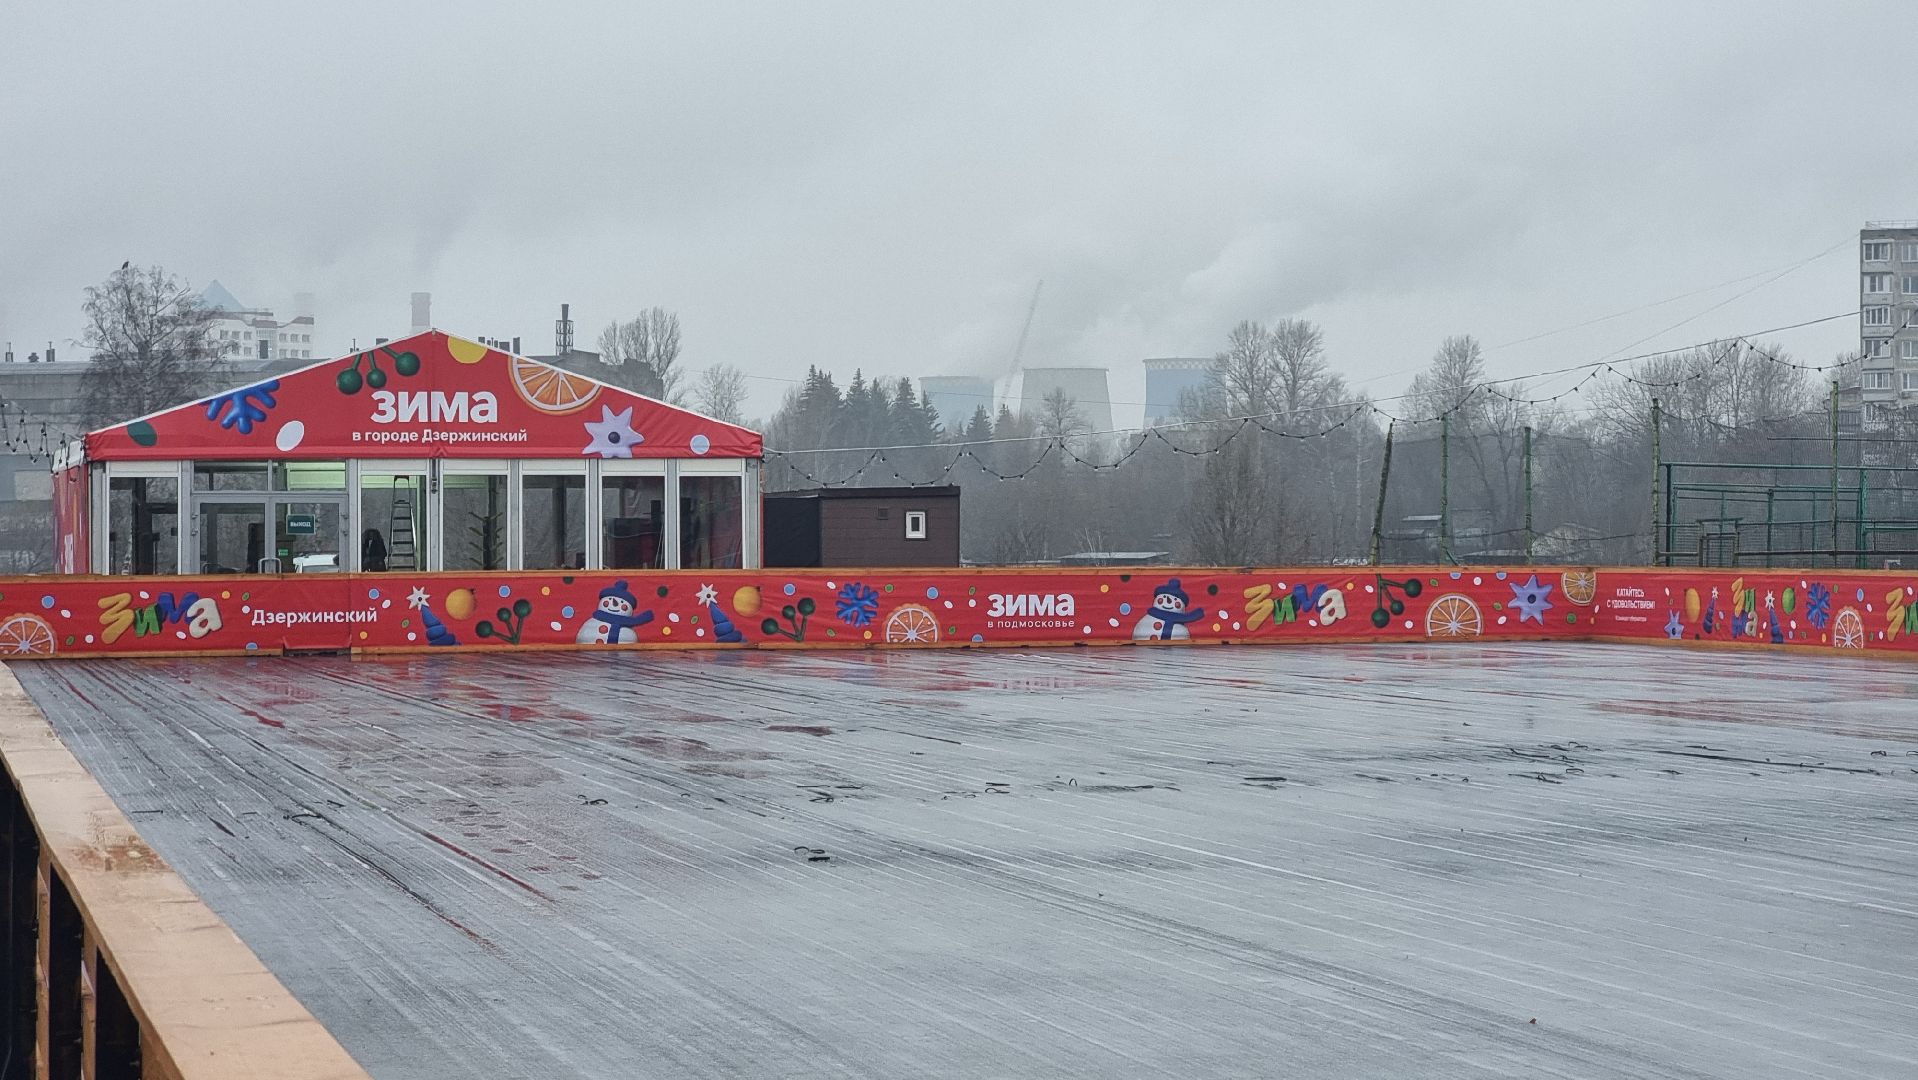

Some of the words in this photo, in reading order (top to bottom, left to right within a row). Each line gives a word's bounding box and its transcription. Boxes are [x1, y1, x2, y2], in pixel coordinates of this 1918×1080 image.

[352, 431, 362, 442] в
[364, 431, 419, 444] городе
[422, 429, 528, 444] Дзержинский
[1606, 599, 1611, 608] С
[251, 608, 377, 627] Дзержинский
[997, 620, 1075, 630] подмосковье
